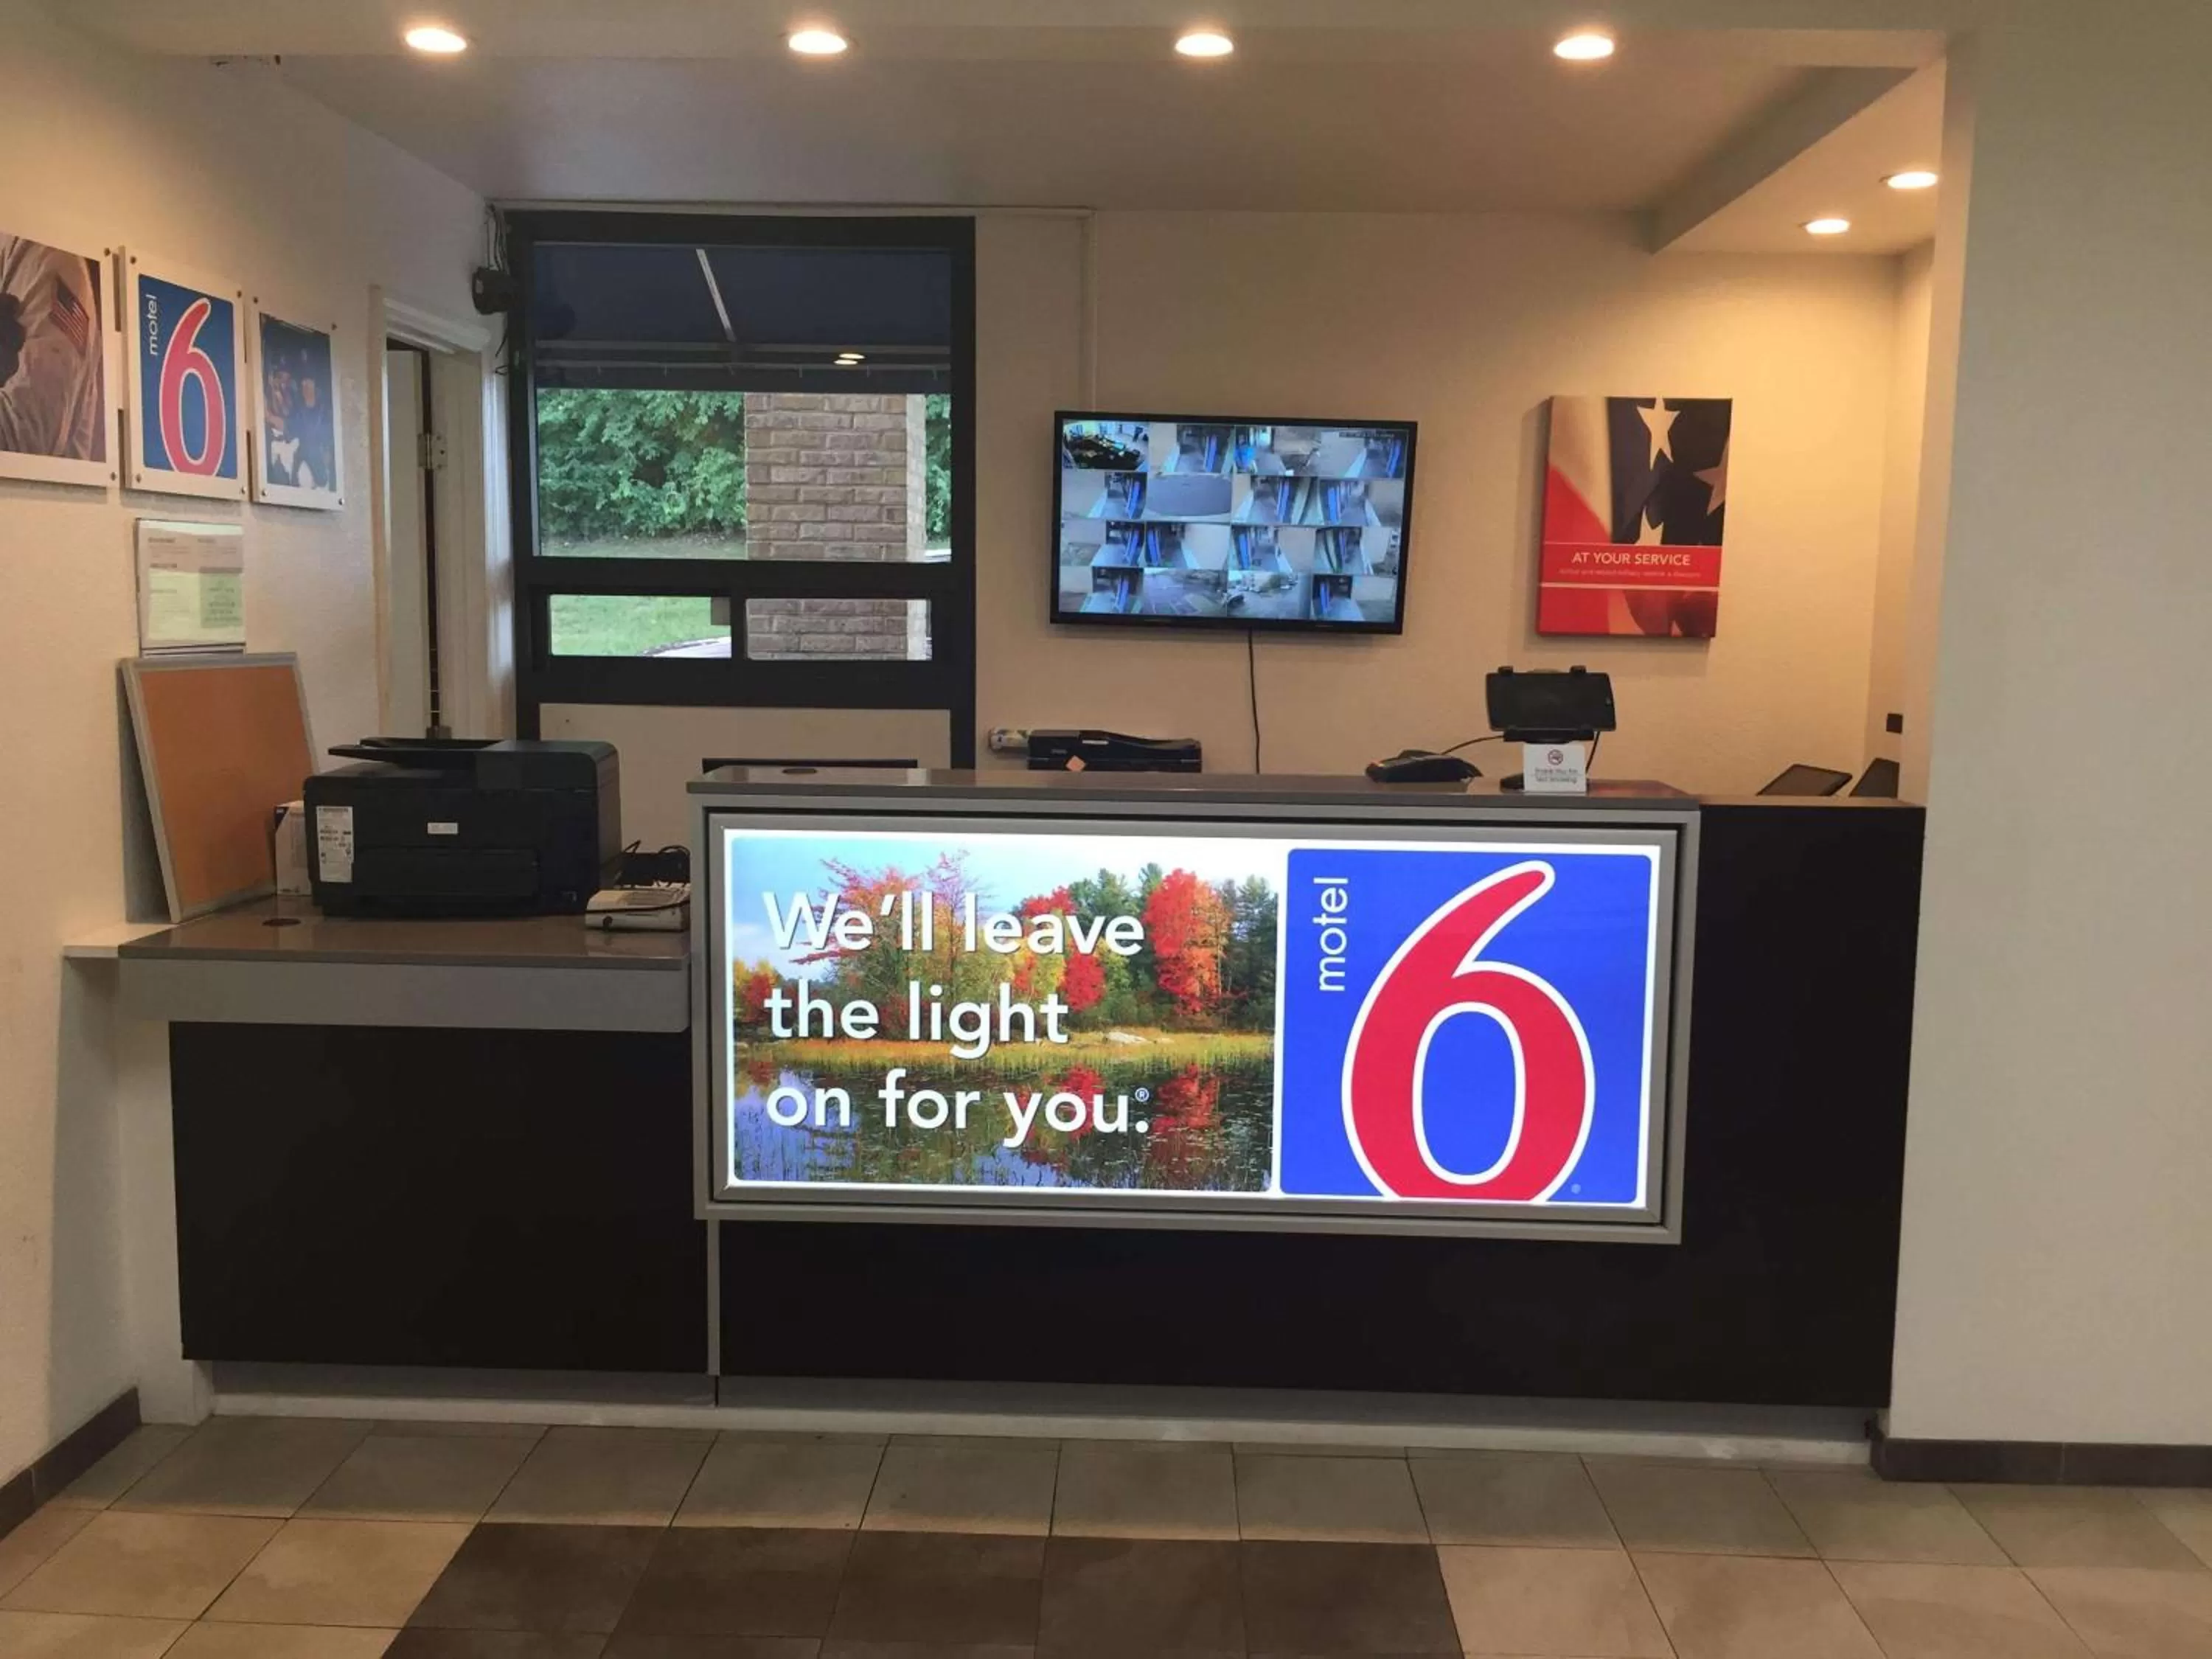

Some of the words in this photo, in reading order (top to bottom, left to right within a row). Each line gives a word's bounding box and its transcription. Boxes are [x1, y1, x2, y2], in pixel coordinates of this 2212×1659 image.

[146, 294, 158, 355] motel
[159, 297, 226, 477] 6
[1571, 552, 1590, 564] AT
[1593, 552, 1630, 565] YOUR
[1634, 554, 1691, 566] SERVICE
[763, 891, 933, 951] We'll
[964, 891, 1146, 956] leave
[1313, 877, 1349, 992] motel
[763, 978, 879, 1039] the
[909, 981, 1069, 1060] light
[1341, 860, 1596, 1202] 6
[765, 1085, 851, 1128] on
[879, 1068, 981, 1130] for
